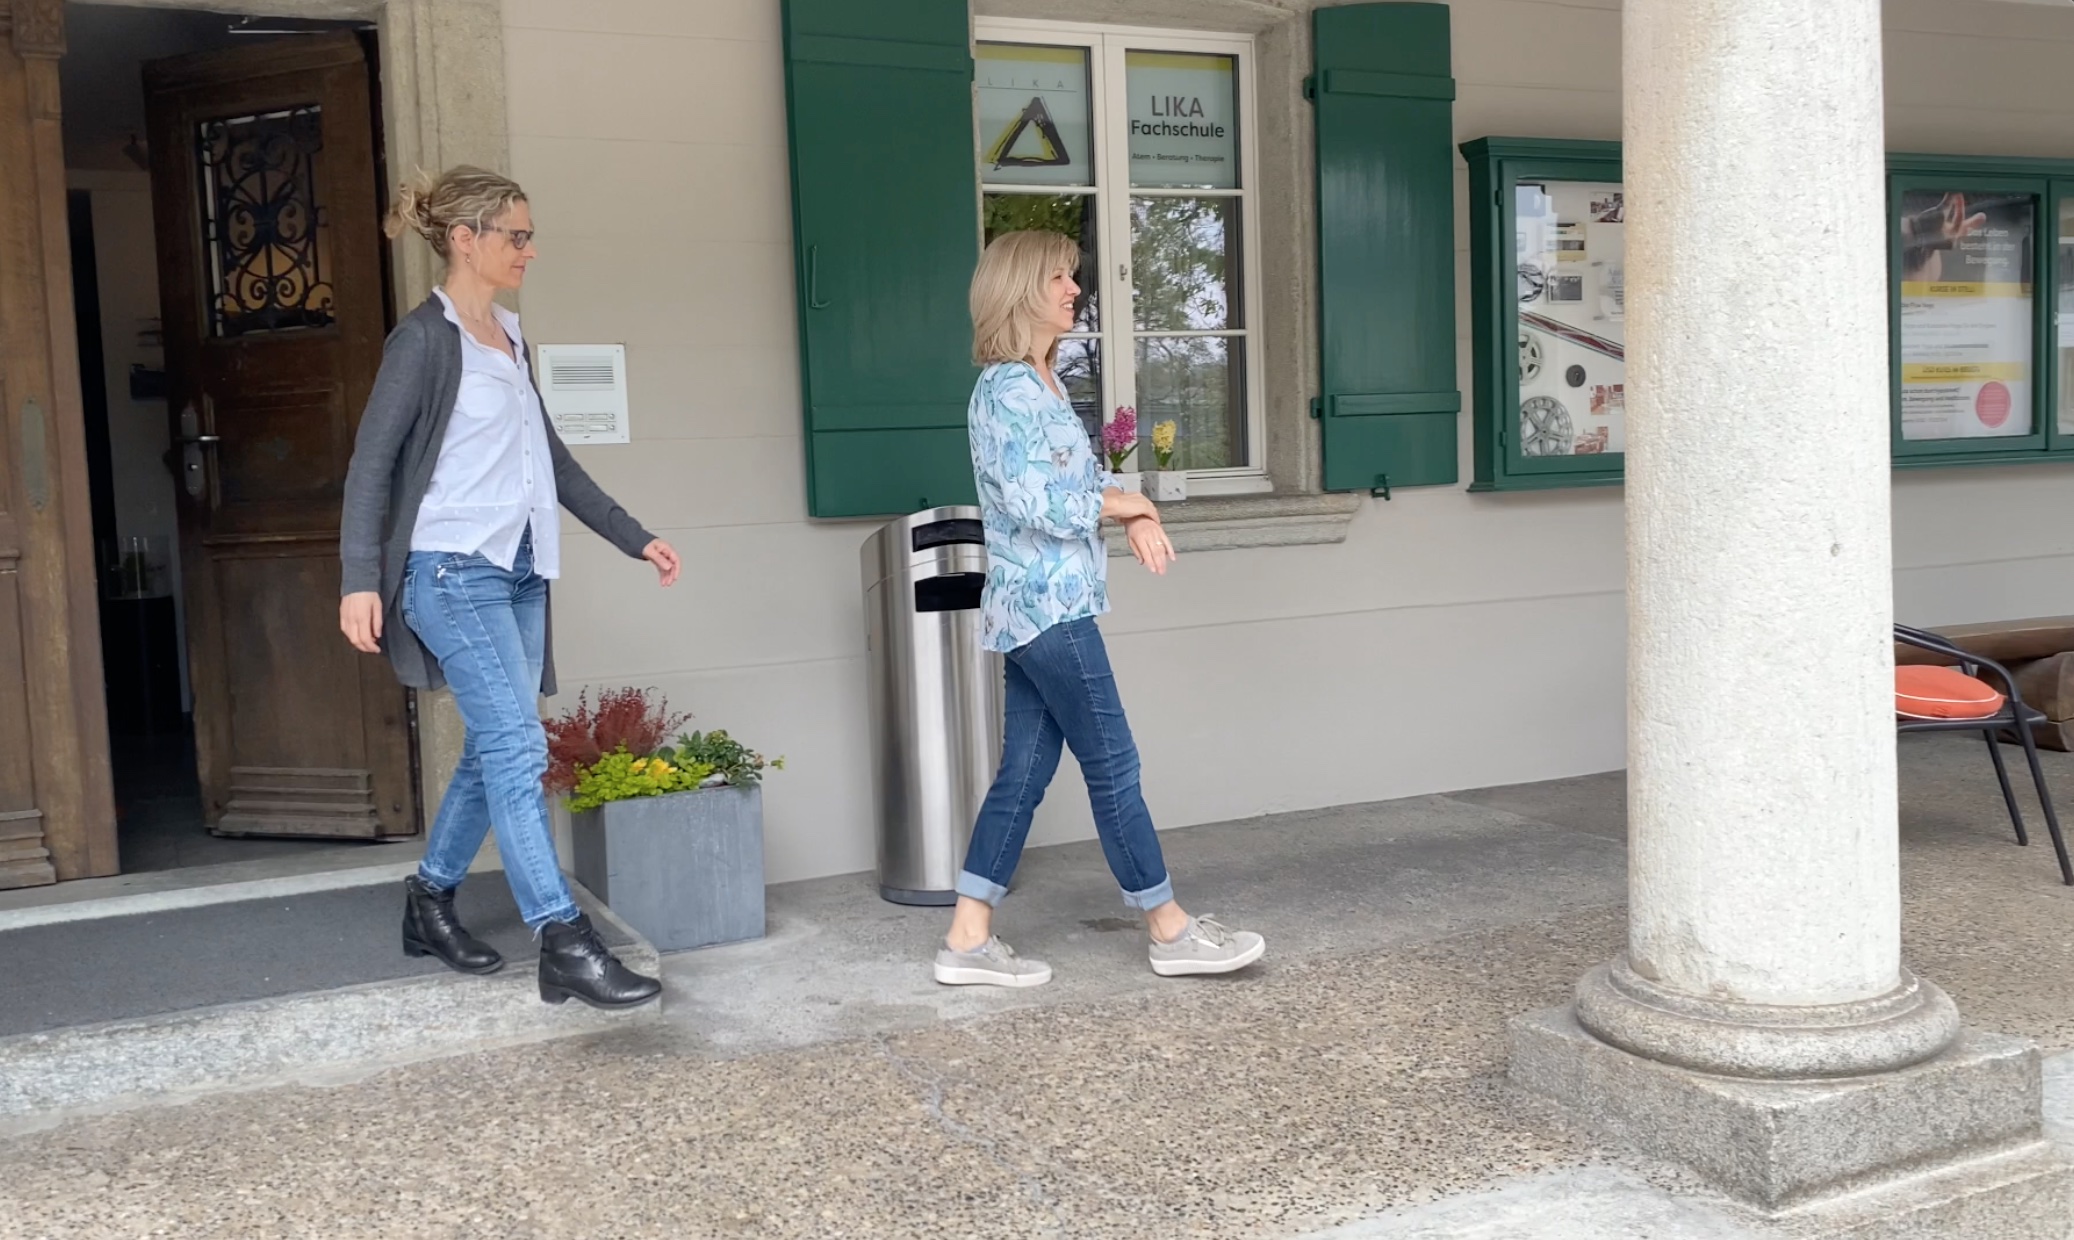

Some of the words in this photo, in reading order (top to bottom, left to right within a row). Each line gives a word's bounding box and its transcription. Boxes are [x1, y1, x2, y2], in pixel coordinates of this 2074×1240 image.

[1151, 95, 1204, 118] LIKA
[1131, 119, 1225, 138] Fachschule
[1156, 153, 1189, 163] Beratung
[1195, 154, 1225, 163] Therapie
